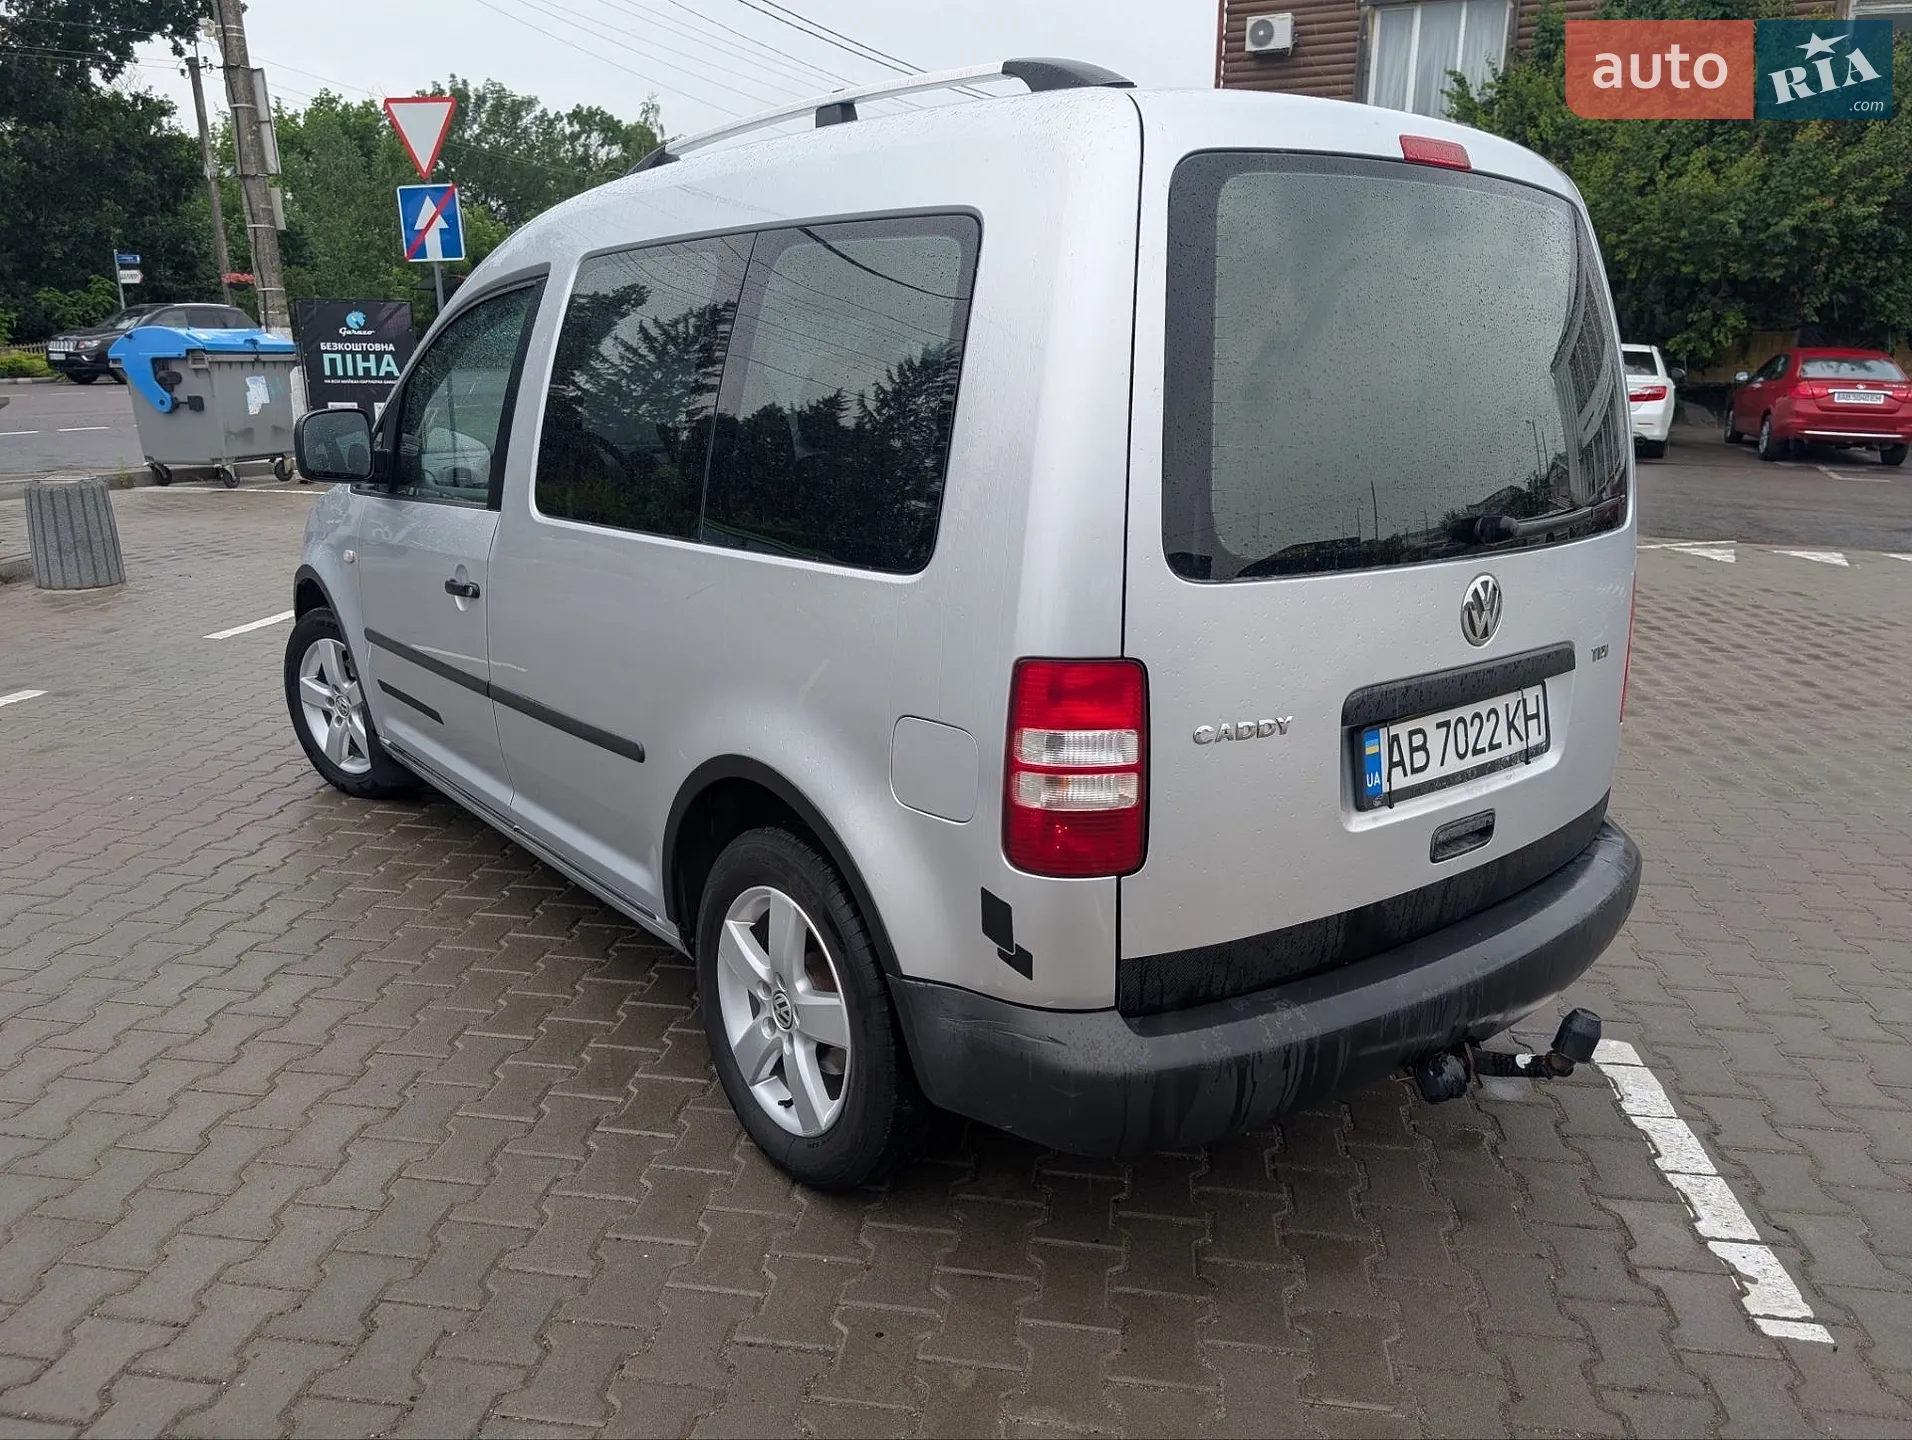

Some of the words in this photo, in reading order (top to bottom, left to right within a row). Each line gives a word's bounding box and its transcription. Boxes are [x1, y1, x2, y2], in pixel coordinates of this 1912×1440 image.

[320, 342, 396, 352] БЕЗКОШТОВНА
[322, 353, 401, 377] ПІНА
[1192, 715, 1294, 745] CADDY
[1388, 727, 1430, 780] AB
[1435, 707, 1502, 767] 7022
[1504, 694, 1542, 746] KH
[1366, 772, 1381, 787] UA
